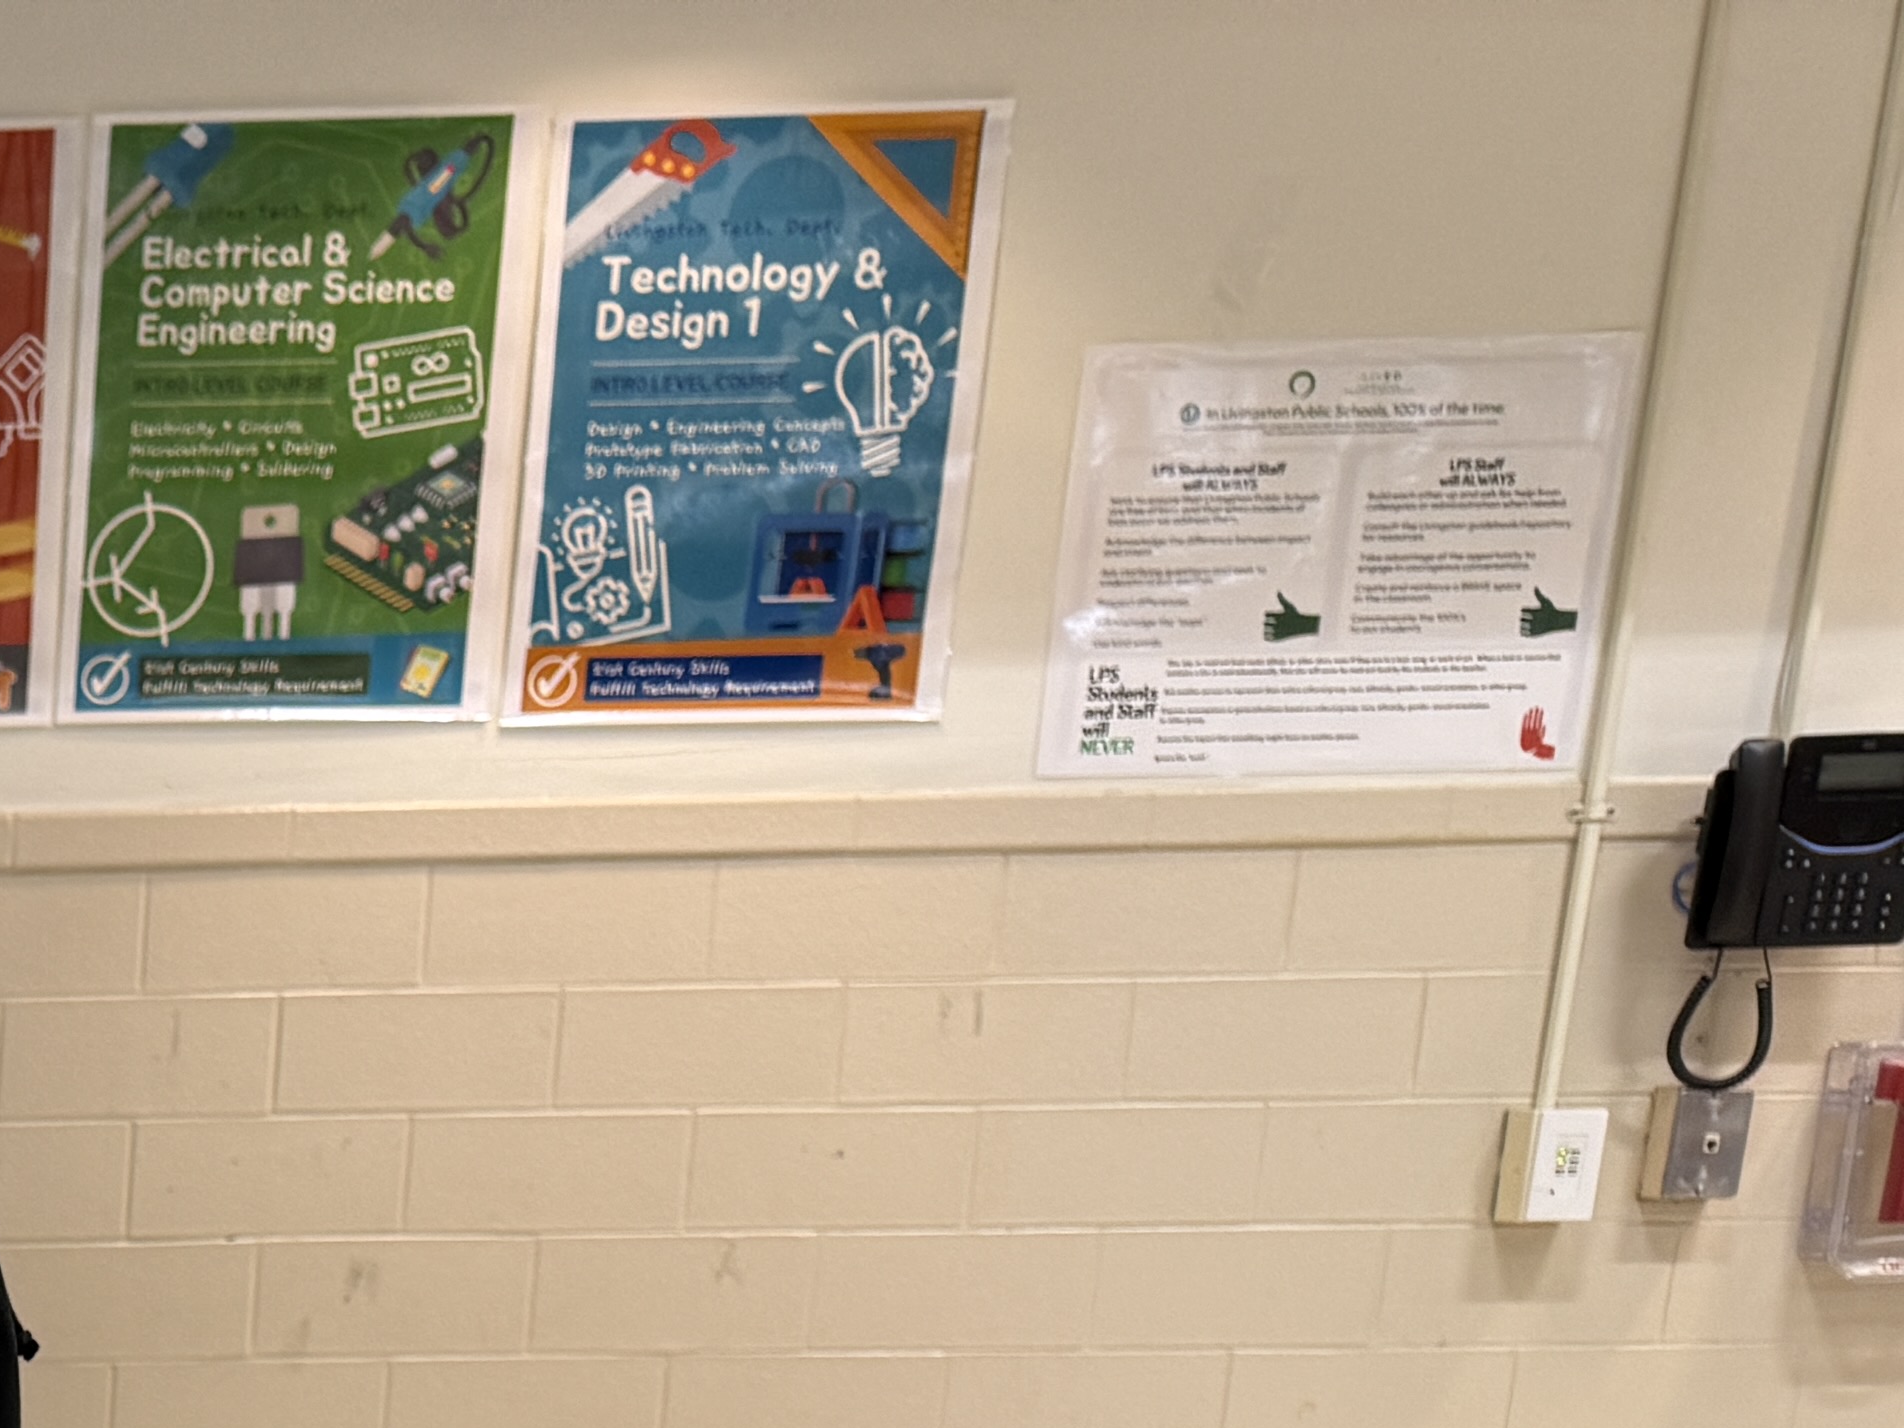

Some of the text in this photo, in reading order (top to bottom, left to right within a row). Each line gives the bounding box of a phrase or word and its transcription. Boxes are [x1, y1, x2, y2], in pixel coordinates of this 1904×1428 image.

[141, 231, 351, 270] Electrical &
[140, 270, 456, 316] Computer Science
[601, 247, 887, 302] Technology &
[136, 311, 337, 355] Engineering
[595, 296, 761, 350] Design 1
[1080, 737, 1135, 756] NEVER
